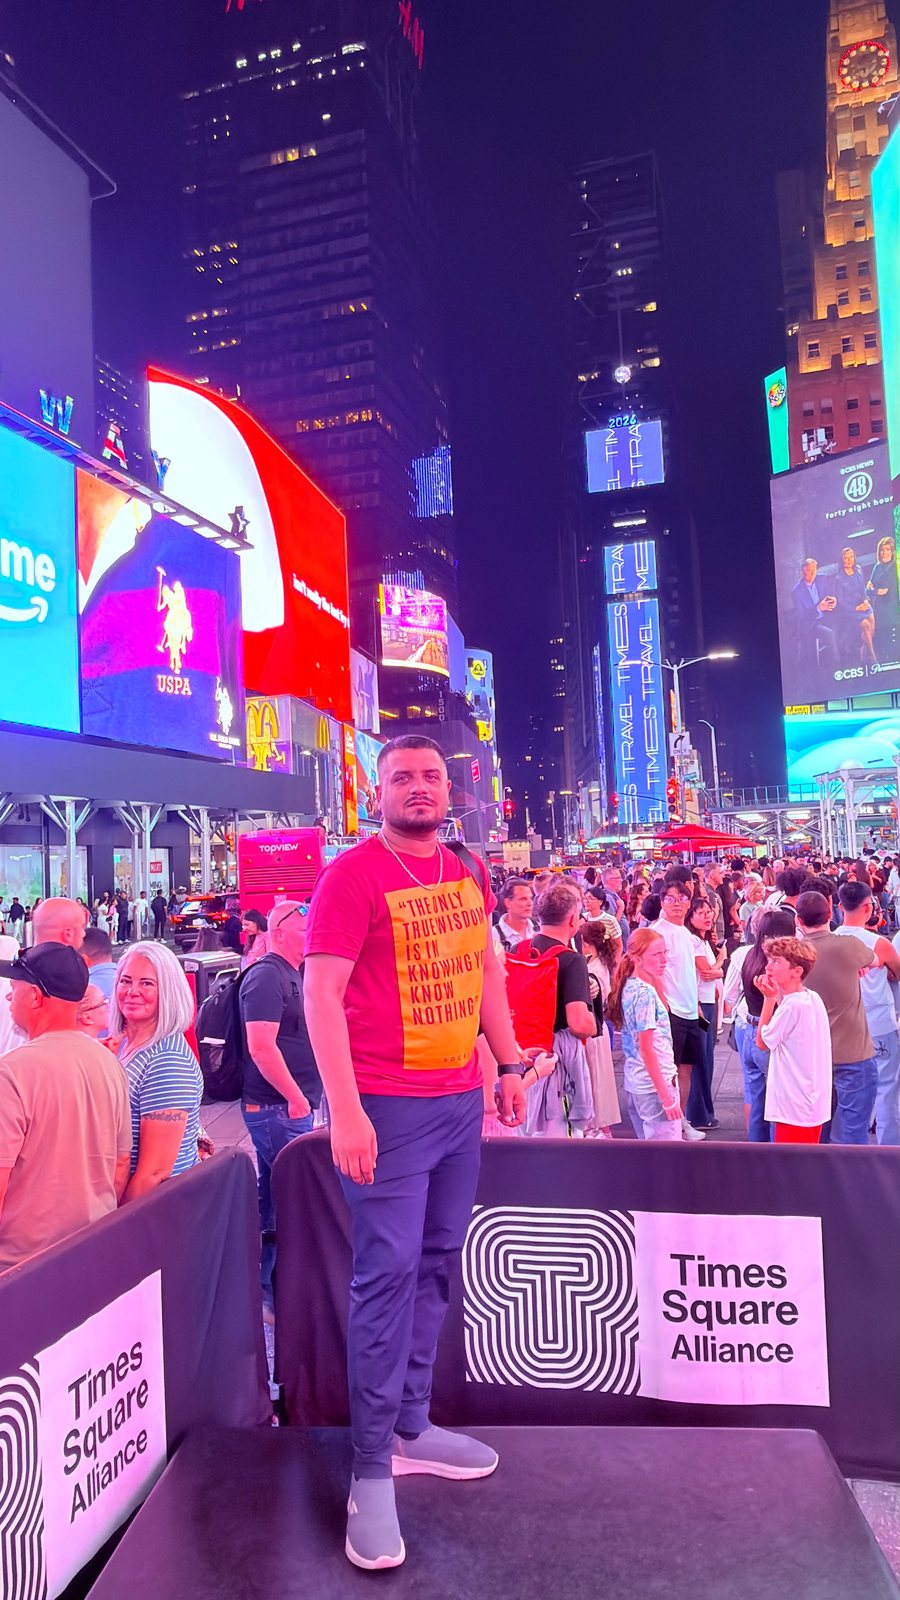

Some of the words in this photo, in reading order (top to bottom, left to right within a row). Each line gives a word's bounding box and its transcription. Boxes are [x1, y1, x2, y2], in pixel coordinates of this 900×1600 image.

[608, 414, 637, 429] 2026
[848, 475, 867, 498] 48
[826, 509, 847, 520] forty
[848, 502, 871, 513] eight
[873, 496, 894, 506] hour
[0, 537, 56, 593] me
[614, 603, 631, 688] TIMES
[639, 616, 657, 701] TRAVEL
[156, 674, 192, 696] USPA
[843, 667, 864, 679] CBS
[619, 694, 636, 778] TRAVEL
[643, 704, 660, 790] TIMES
[406, 943, 421, 961] IS
[425, 940, 440, 959] IN
[407, 953, 473, 983] KNOWING
[410, 980, 454, 1004] KNOW
[670, 1253, 788, 1289] Times
[662, 1289, 799, 1332] Square
[671, 1334, 794, 1363] Alliance
[67, 1341, 144, 1421] Times
[63, 1378, 150, 1475] Square
[70, 1428, 149, 1524] Alliance
